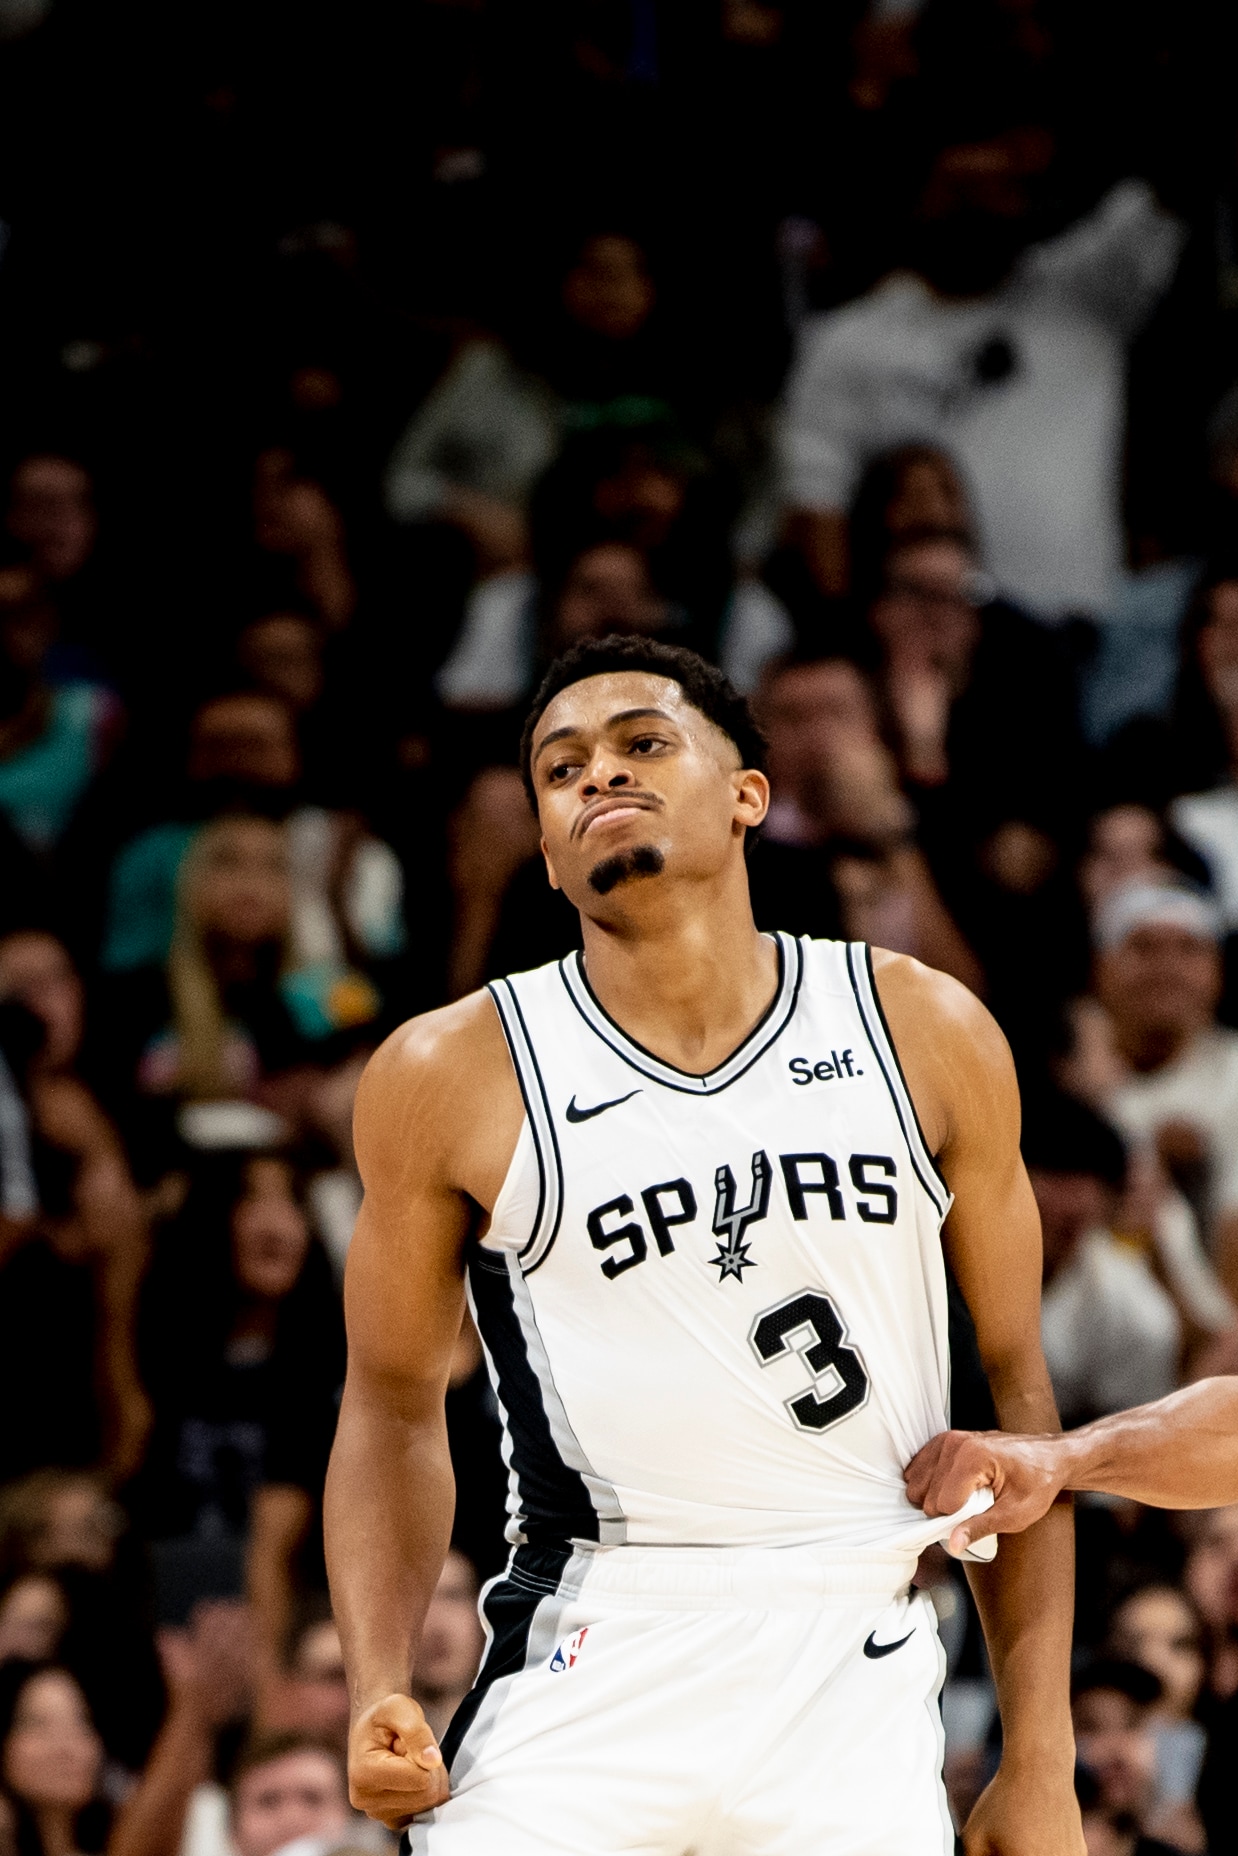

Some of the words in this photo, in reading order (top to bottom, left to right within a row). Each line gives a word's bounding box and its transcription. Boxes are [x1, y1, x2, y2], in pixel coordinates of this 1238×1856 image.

[789, 1050, 864, 1085] Self.
[587, 1150, 898, 1283] SPURS
[747, 1287, 870, 1435] 3
